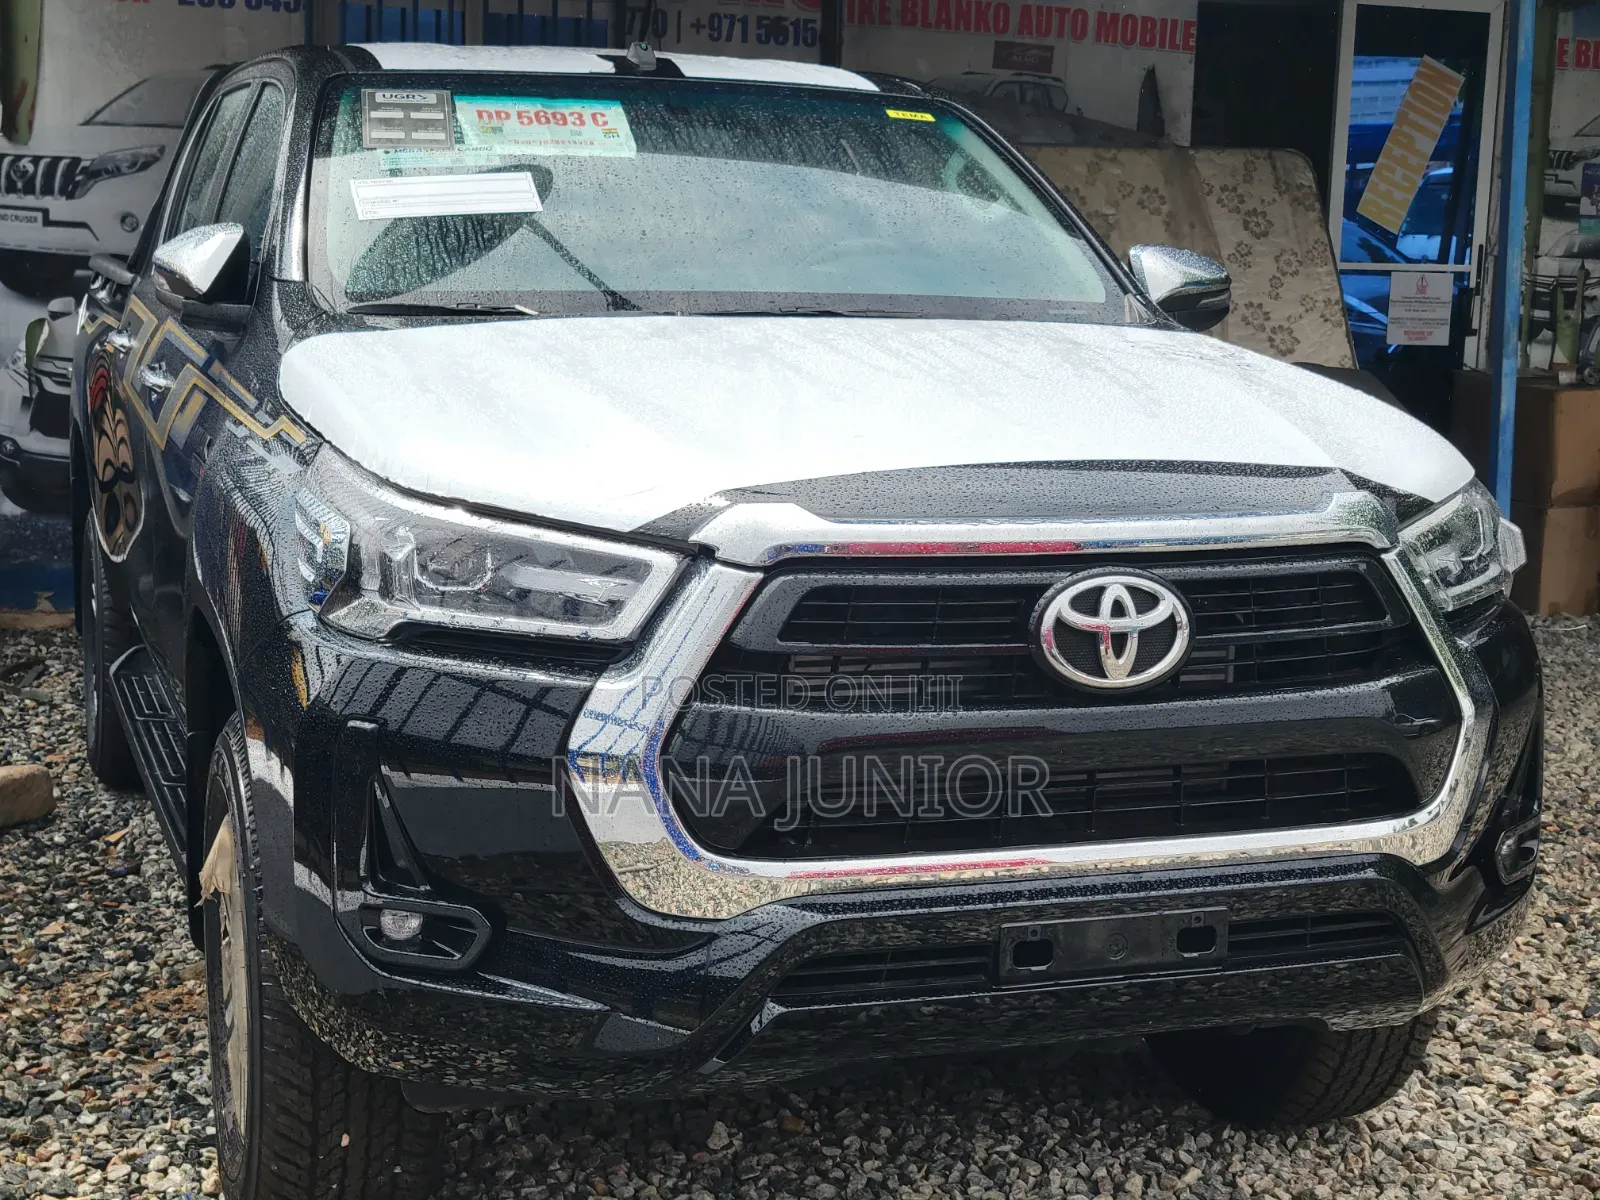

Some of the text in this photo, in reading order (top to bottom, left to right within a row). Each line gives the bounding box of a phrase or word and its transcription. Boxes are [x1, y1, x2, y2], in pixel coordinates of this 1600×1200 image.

[690, 12, 749, 44] +971
[899, 0, 1010, 35] BLANKO
[1016, 3, 1087, 40] AUTO
[1094, 13, 1198, 52] MOBILE
[476, 109, 609, 127] DP 5693 C
[892, 111, 929, 119] TEMA
[1357, 57, 1463, 233] RECEPTION
[10, 213, 38, 223] CRUISER
